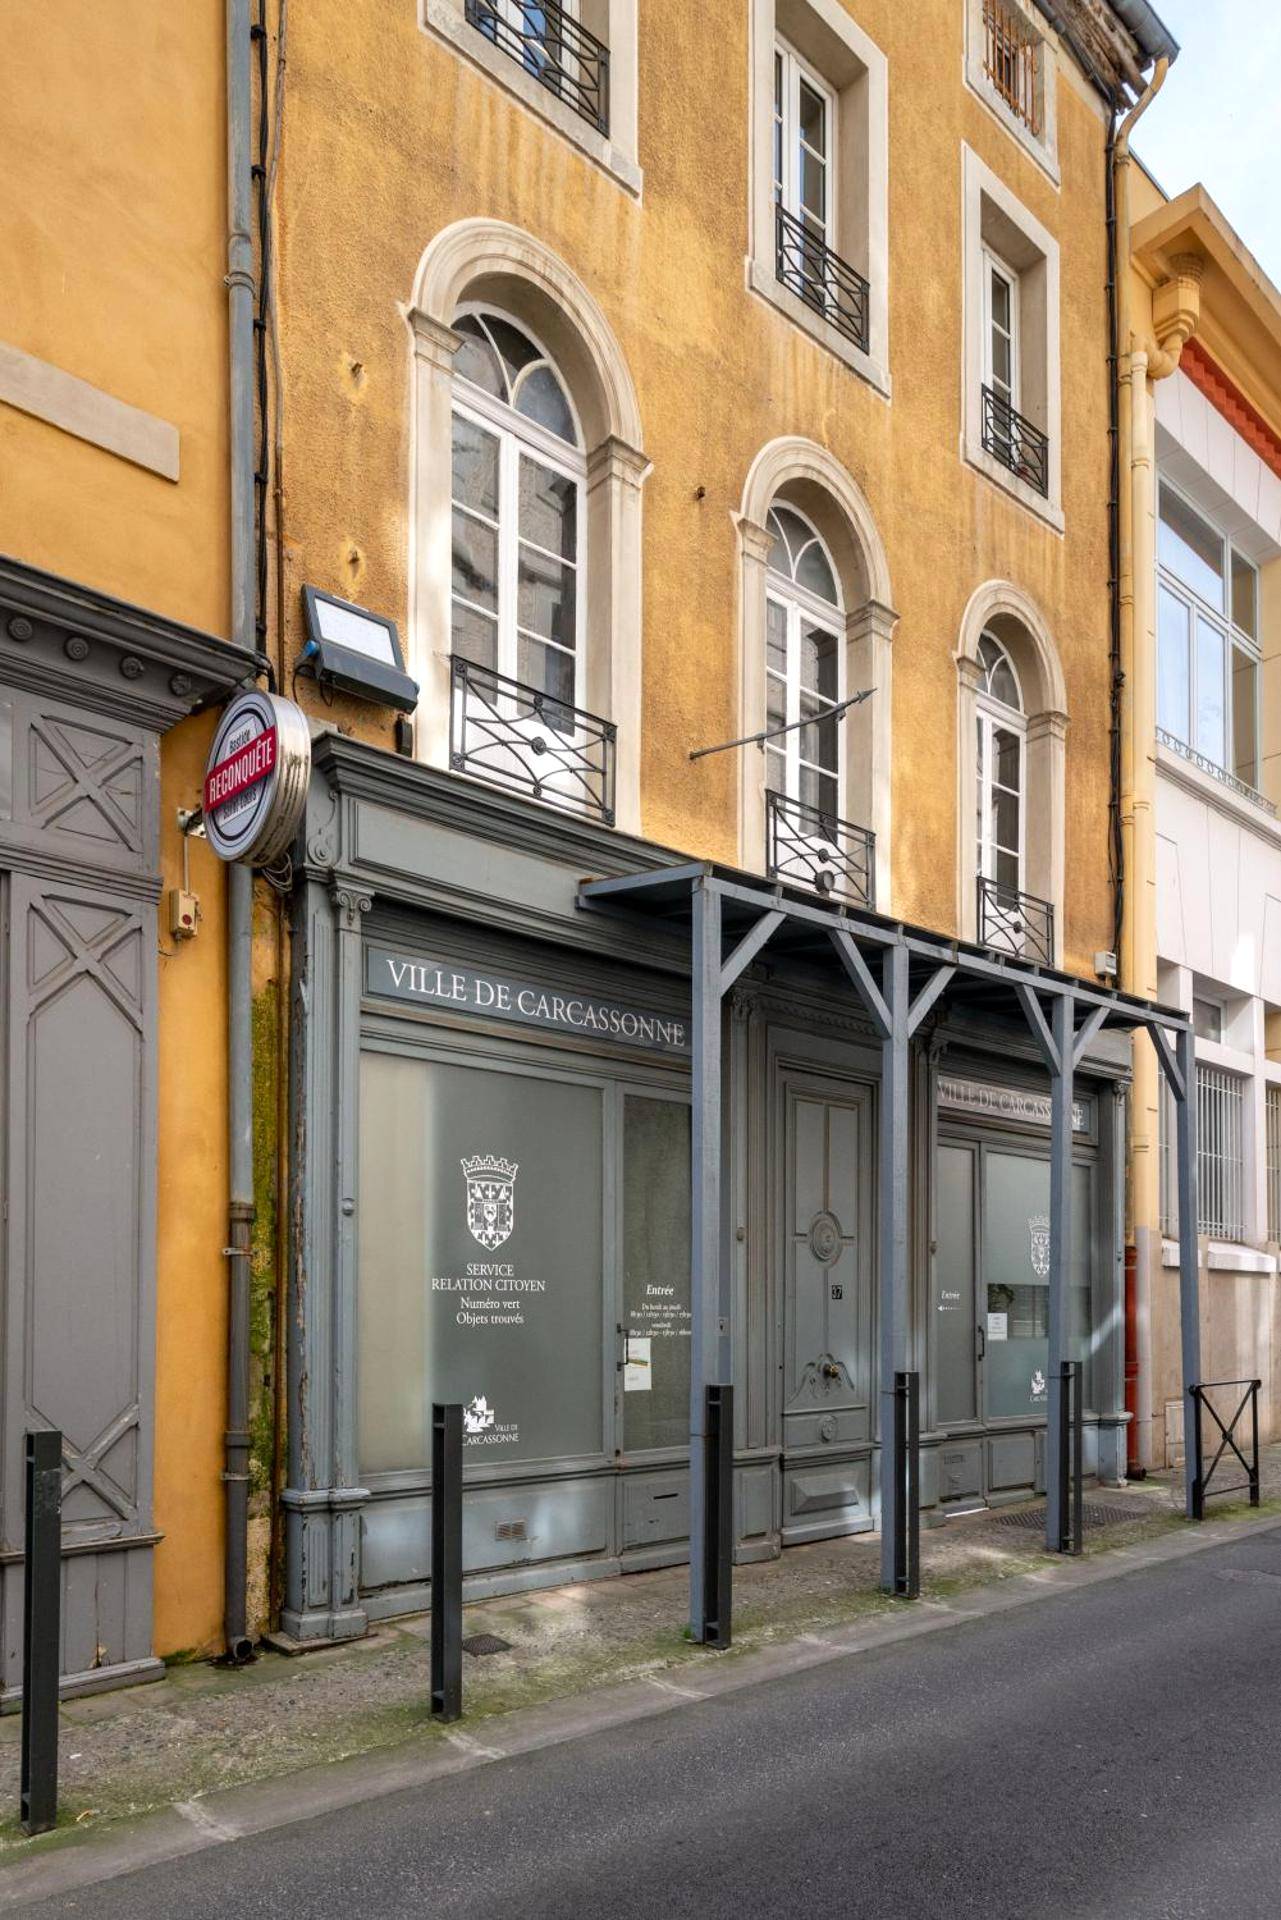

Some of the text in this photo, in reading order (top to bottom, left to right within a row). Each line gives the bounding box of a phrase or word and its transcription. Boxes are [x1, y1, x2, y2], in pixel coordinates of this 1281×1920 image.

[209, 736, 273, 804] RECONQUÊTE
[386, 959, 685, 1047] VILLE DE CARCASSONNE
[937, 1080, 977, 1105] VILLE
[979, 1089, 998, 1109] DE
[466, 1263, 514, 1276] SERVICE
[431, 1278, 546, 1292] RELATION CITOYEN
[646, 1284, 674, 1295] Entrée
[460, 1296, 520, 1309] Numéro vert
[456, 1311, 524, 1328] Objets trouvés
